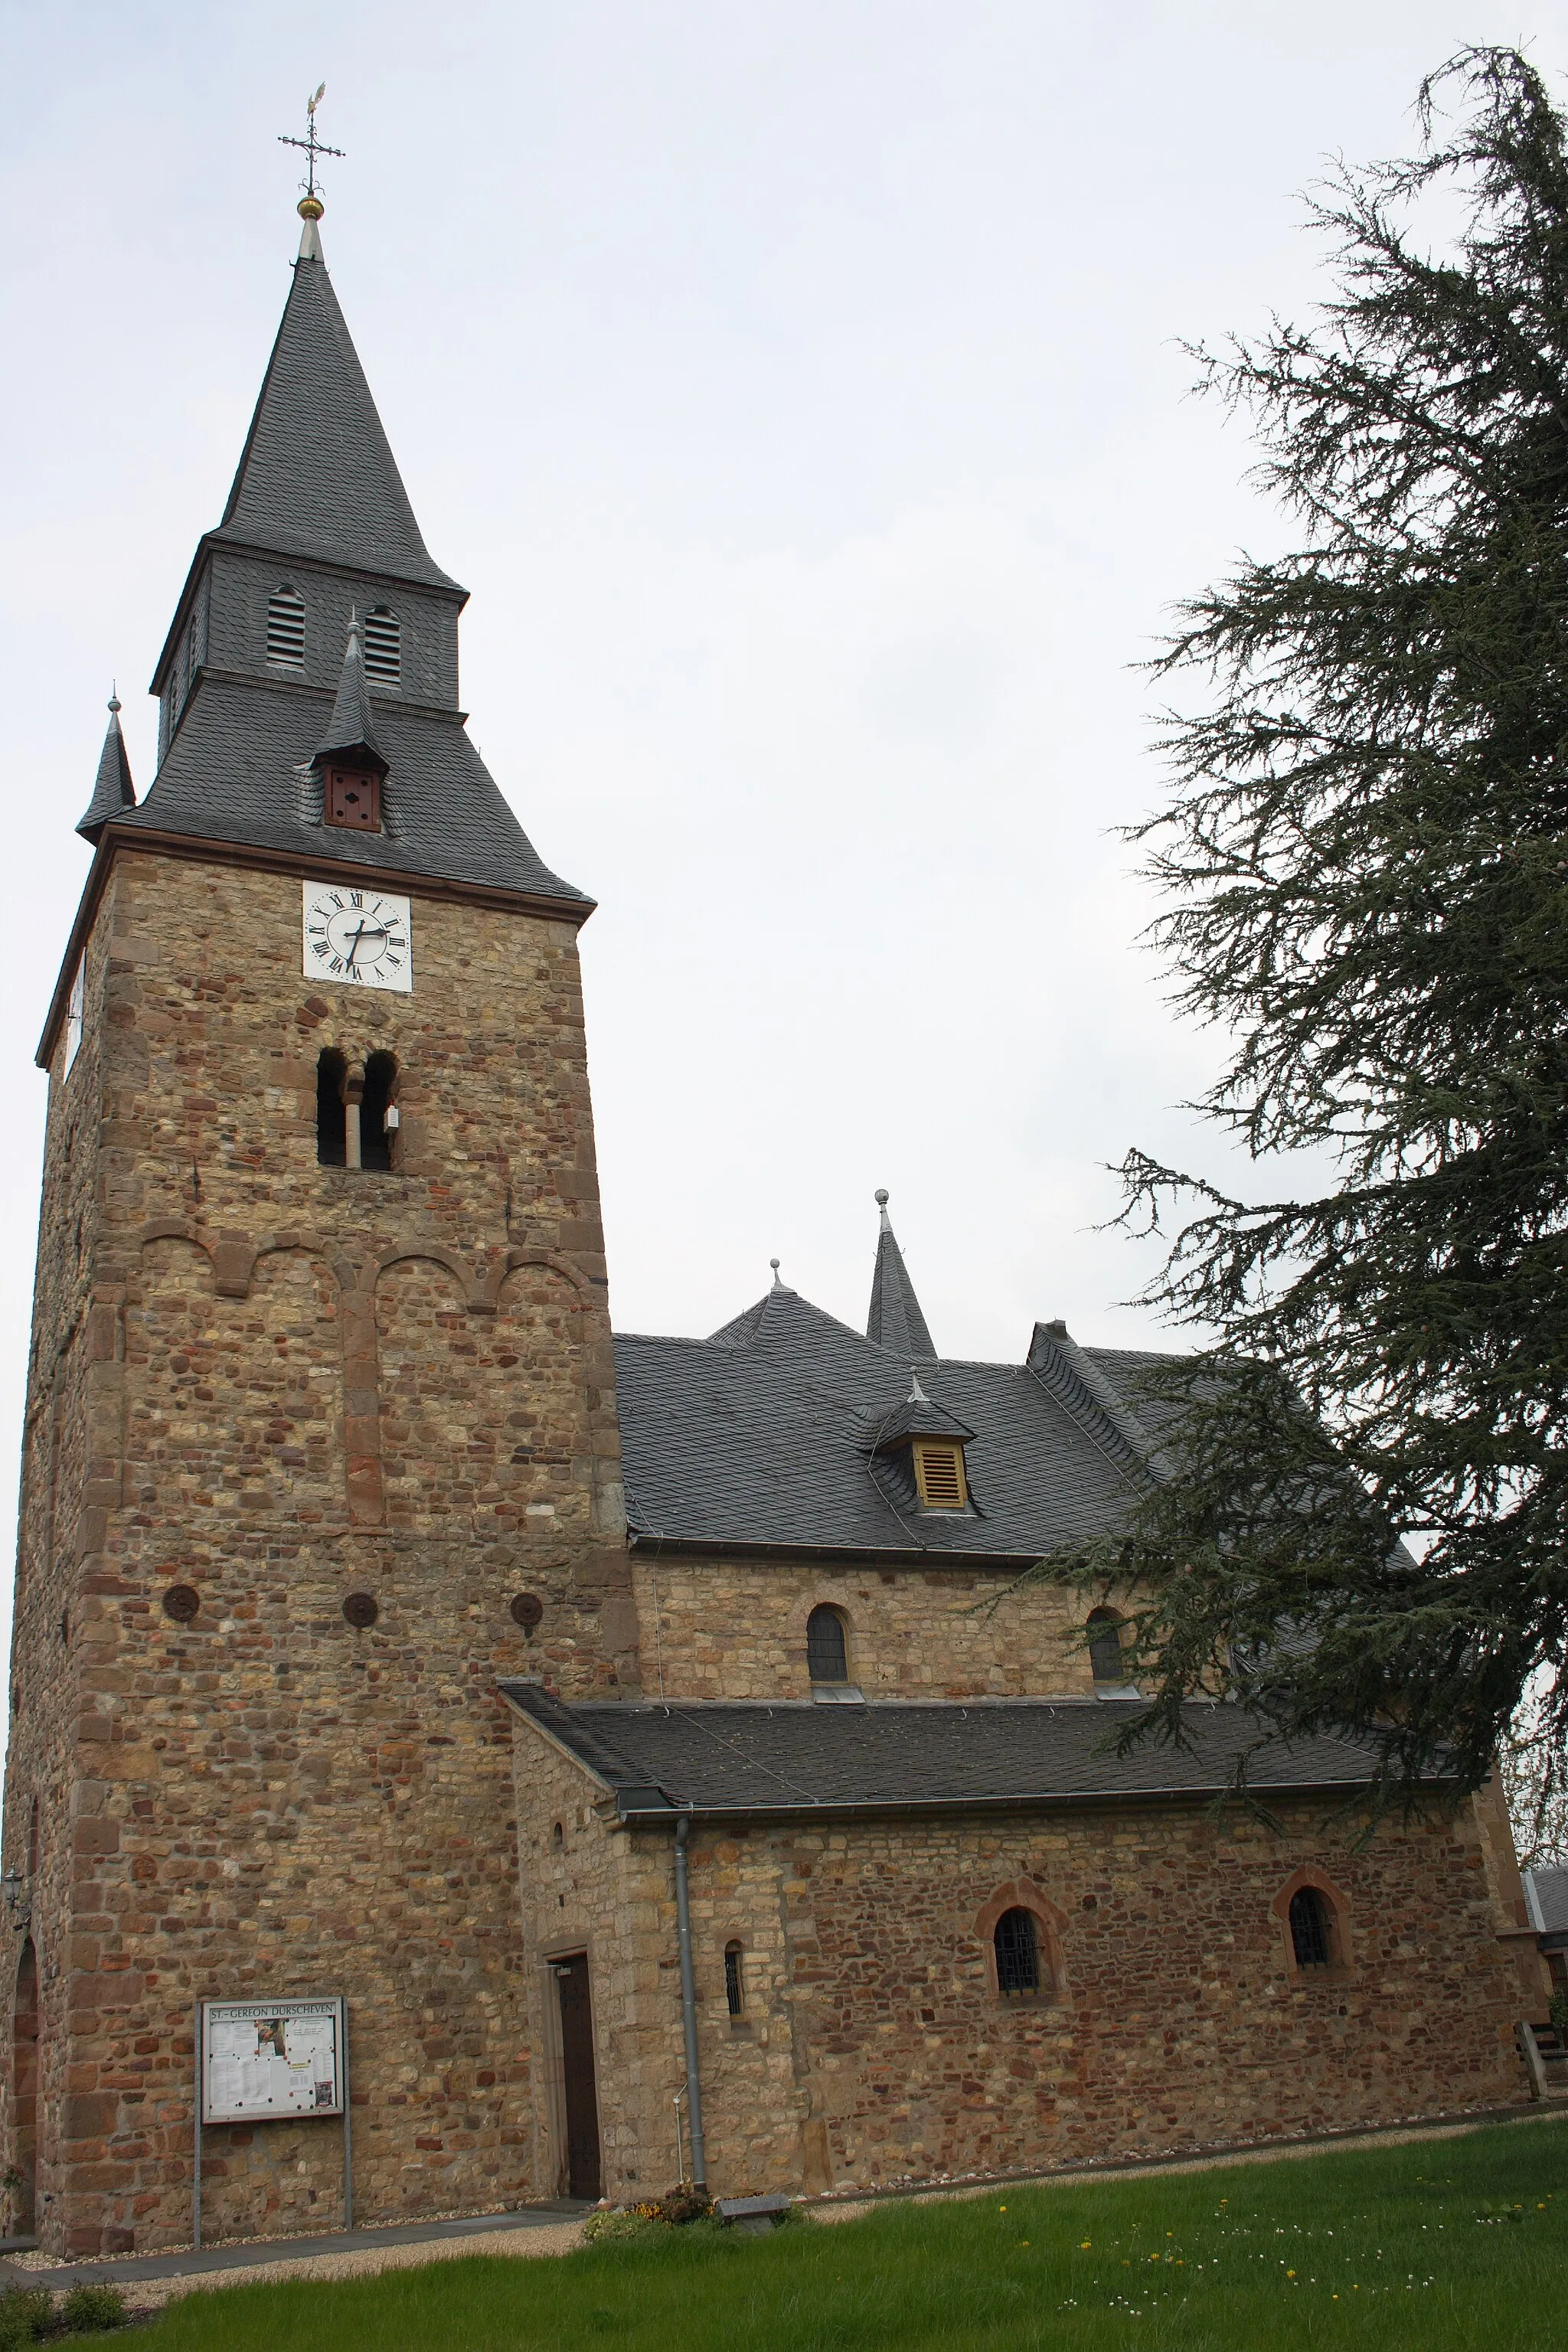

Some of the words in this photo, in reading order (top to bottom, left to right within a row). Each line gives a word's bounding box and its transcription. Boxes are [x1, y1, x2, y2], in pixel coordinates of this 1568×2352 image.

[329, 894, 345, 910] XI
[350, 893, 362, 908] XII
[314, 906, 330, 919] X
[371, 902, 381, 914] I
[309, 924, 325, 935] IX
[384, 919, 399, 928] II
[390, 937, 405, 947] III
[313, 941, 332, 958] VIII
[328, 956, 345, 973] VII
[386, 952, 400, 967] IV
[352, 965, 362, 980] VI
[374, 965, 384, 978] V
